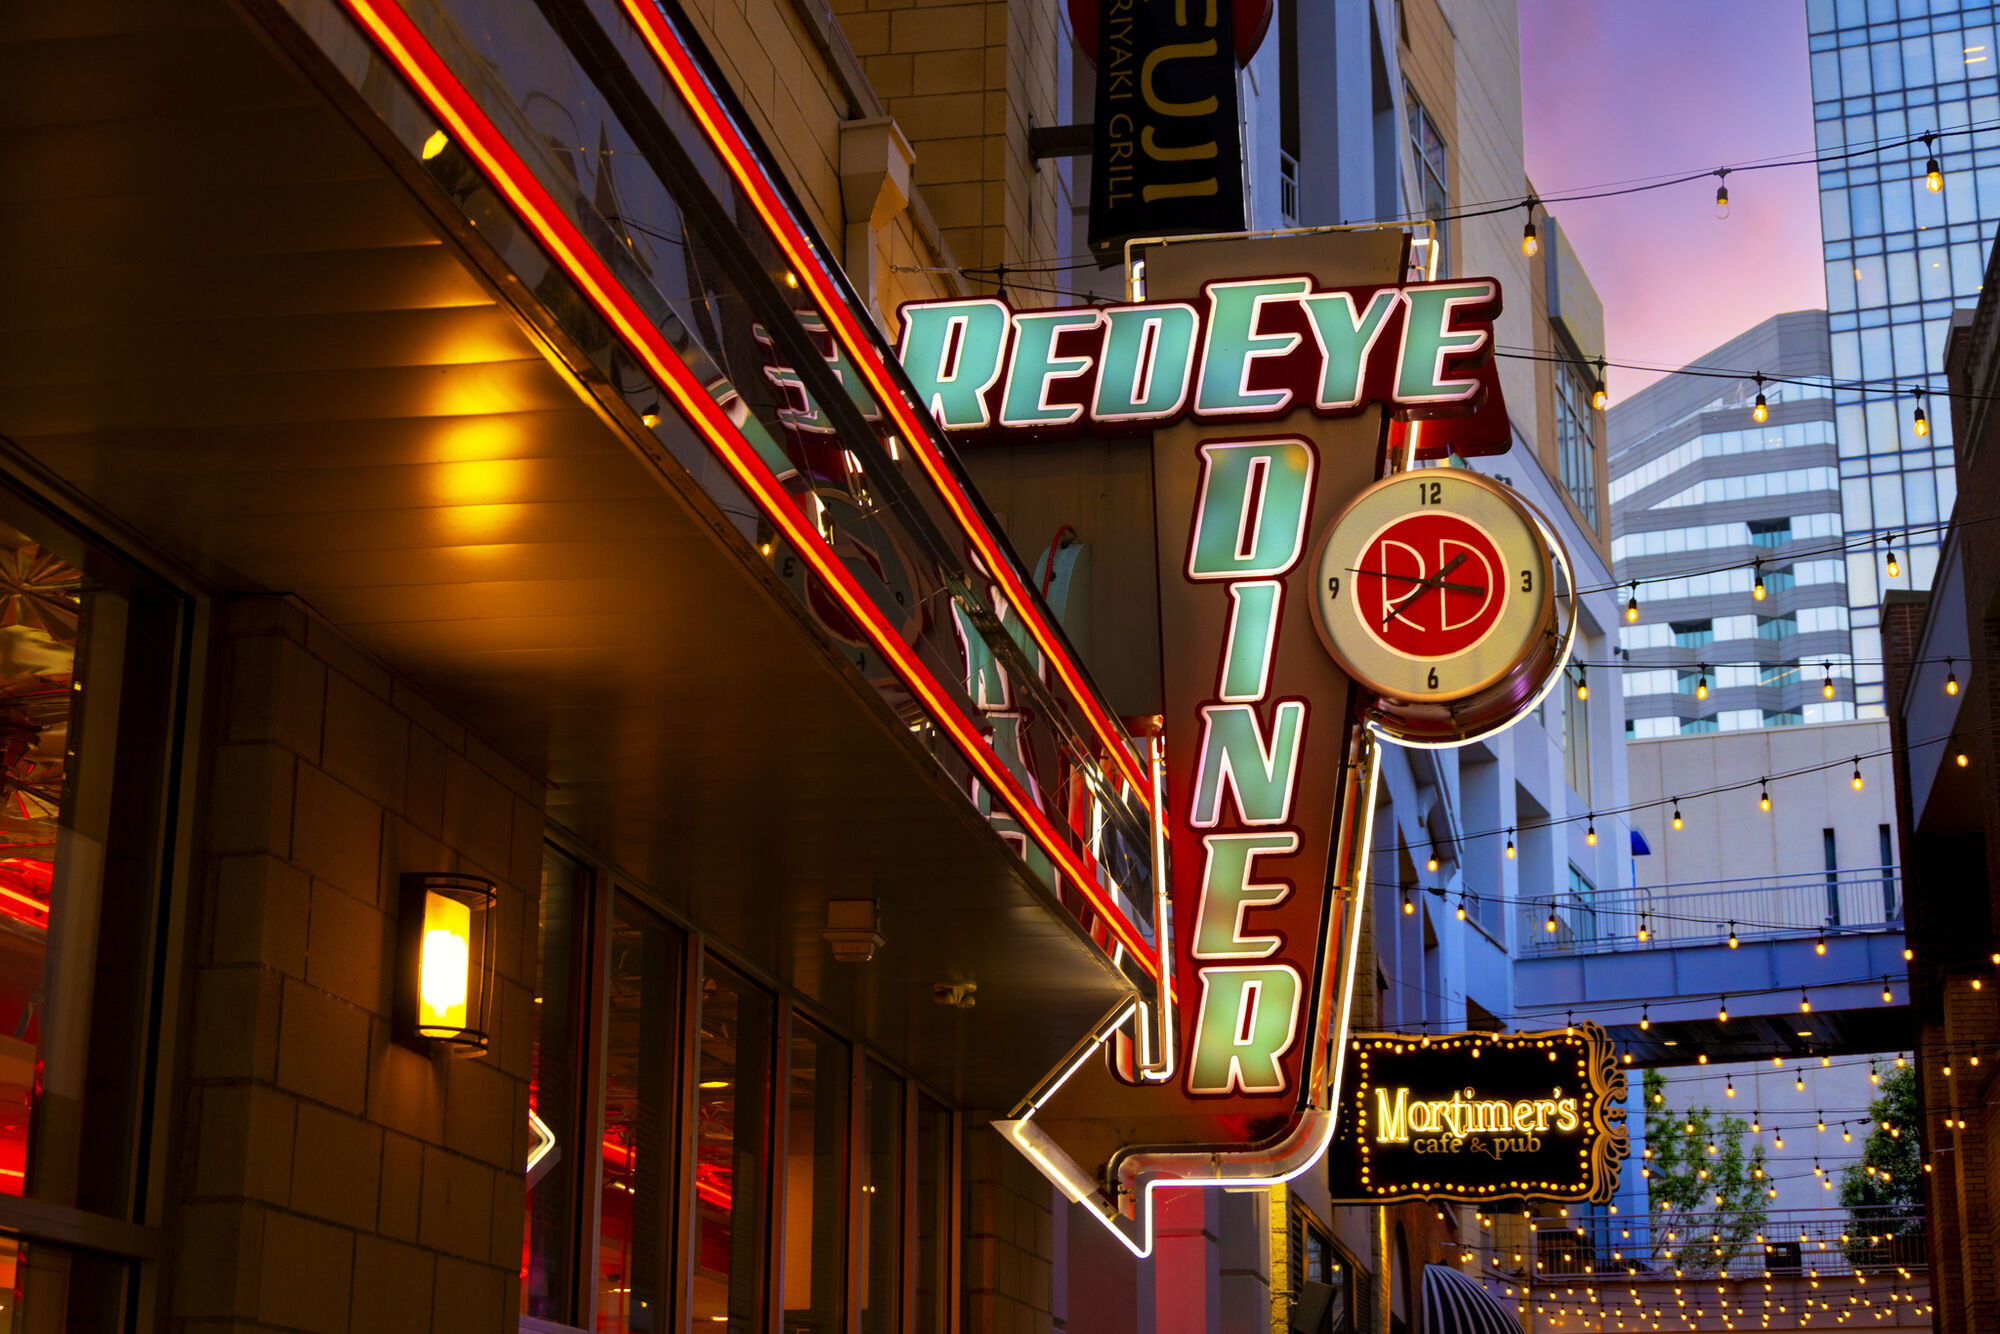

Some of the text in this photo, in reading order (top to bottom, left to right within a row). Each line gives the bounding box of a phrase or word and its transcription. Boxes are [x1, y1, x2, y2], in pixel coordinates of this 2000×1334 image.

[1109, 113, 1134, 208] GRILL
[901, 276, 1496, 431] REDEYE
[1420, 482, 1441, 504] 12
[1328, 577, 1339, 599] 9
[1381, 539, 1493, 632] RD
[1521, 570, 1532, 592] 3
[1428, 667, 1438, 689] 6
[1187, 439, 1316, 1095] DINER
[1375, 1087, 1579, 1143] Mortimer's
[1413, 1131, 1464, 1154] cafe
[1493, 1131, 1541, 1160] pub
